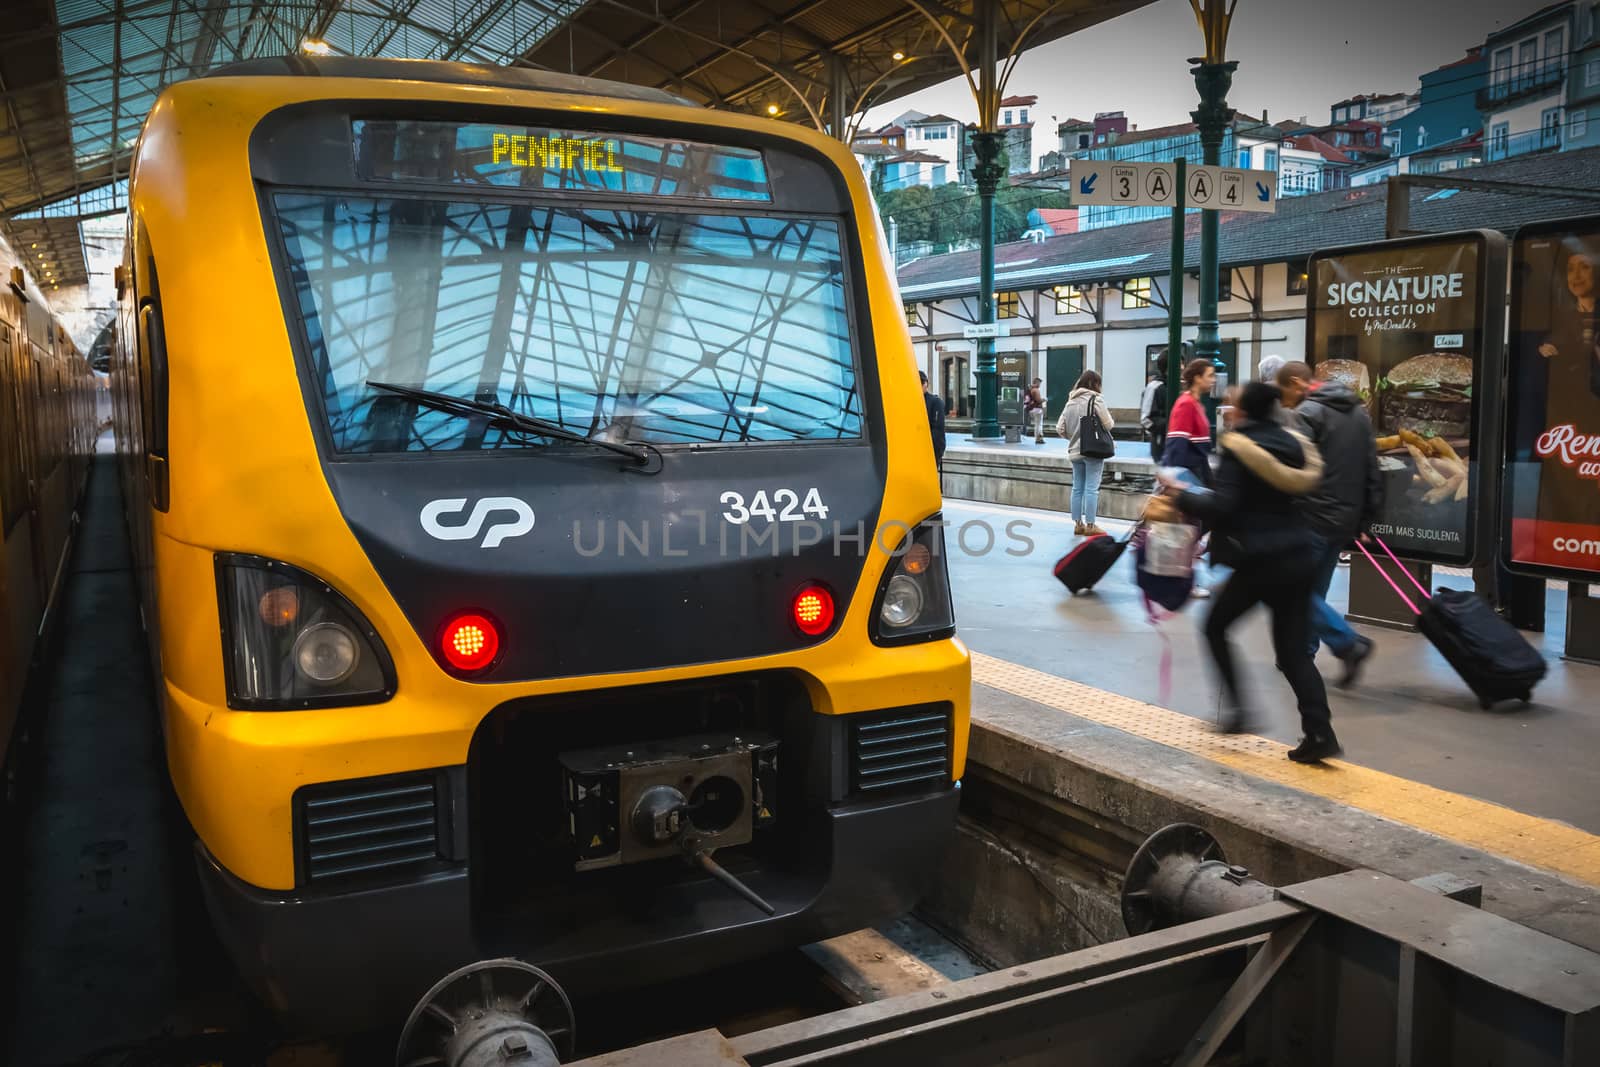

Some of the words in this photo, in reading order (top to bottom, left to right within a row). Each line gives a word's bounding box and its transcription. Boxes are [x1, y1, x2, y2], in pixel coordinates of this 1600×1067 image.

[492, 133, 624, 173] PENAFIEL
[1115, 168, 1133, 177] Linha
[1119, 177, 1130, 198] 3
[1151, 175, 1166, 196] A
[1193, 177, 1208, 198] A
[1226, 183, 1237, 203] 4
[1385, 265, 1401, 275] THE
[1327, 272, 1464, 306] SIGNATURE
[1349, 302, 1436, 318] COLLECTION
[1364, 319, 1373, 336] by
[1373, 318, 1417, 331] McDonald's
[719, 487, 829, 525] 3424
[420, 497, 535, 548] CP
[1396, 526, 1415, 537] MAIS
[1417, 528, 1460, 543] SUCULENTA
